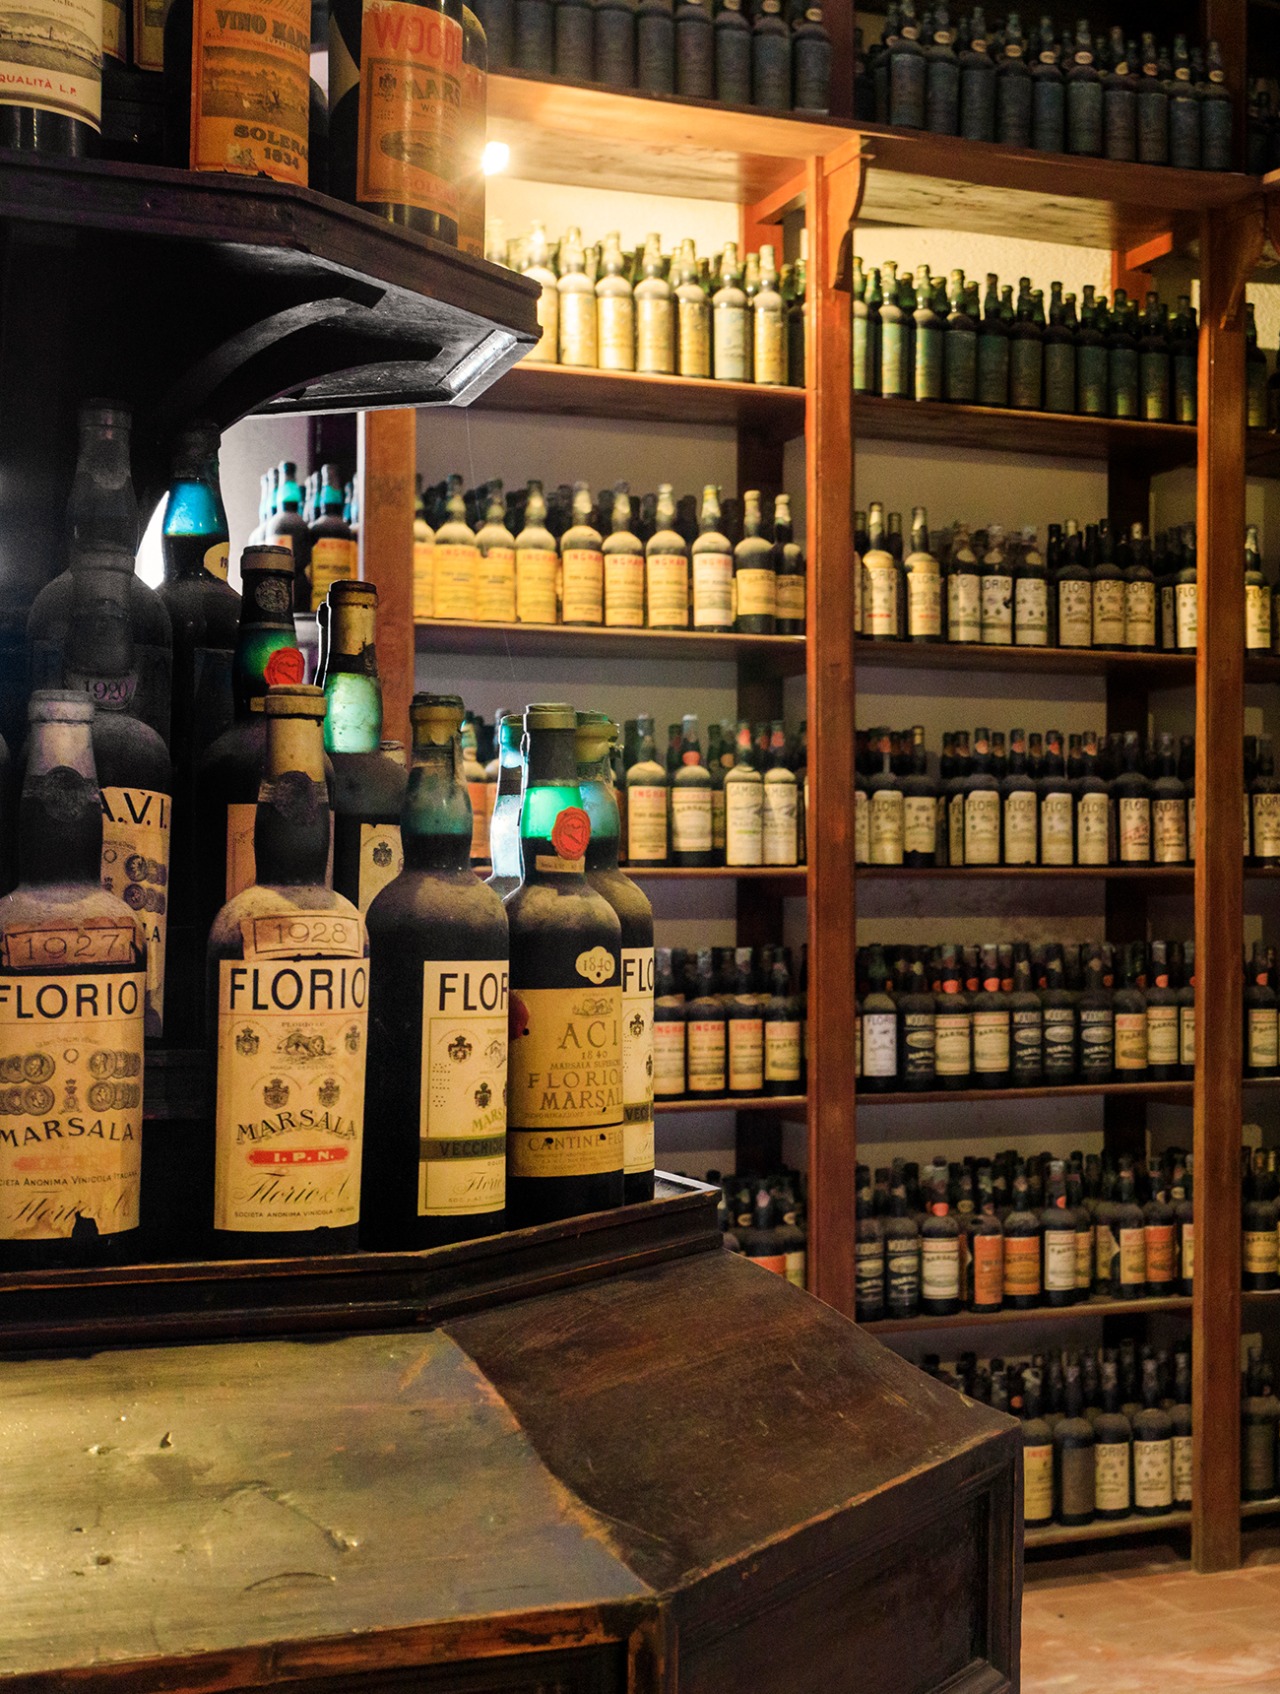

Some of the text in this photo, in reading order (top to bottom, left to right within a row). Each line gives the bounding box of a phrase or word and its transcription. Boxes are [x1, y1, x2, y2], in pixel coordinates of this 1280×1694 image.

[215, 9, 268, 35] VINO
[274, 921, 349, 945] 1928
[24, 933, 121, 960] 1927
[583, 959, 612, 972] 1840
[229, 966, 366, 1011] FLORIO
[581, 1050, 608, 1061] 1840
[527, 1068, 618, 1089] FLORIO
[0, 1117, 134, 1148] MARSALA
[236, 1109, 357, 1144] MARSALA
[24, 1177, 68, 1187] ANONIMA
[71, 1174, 112, 1185] VINICOLA
